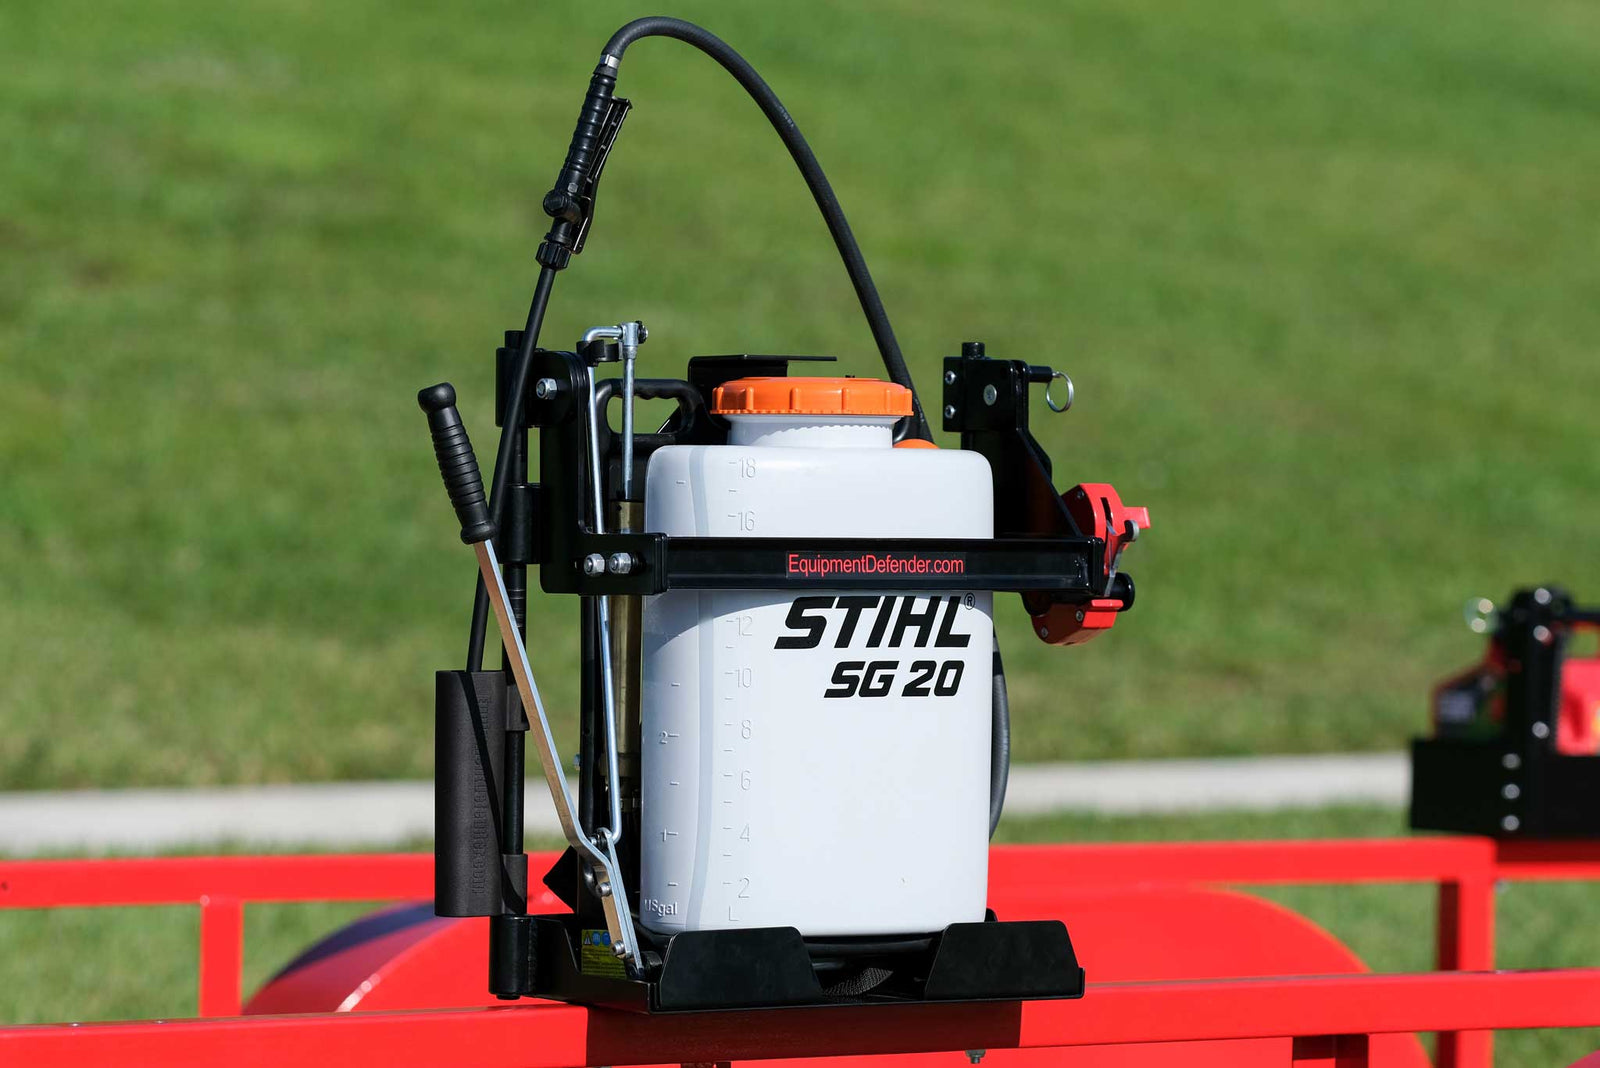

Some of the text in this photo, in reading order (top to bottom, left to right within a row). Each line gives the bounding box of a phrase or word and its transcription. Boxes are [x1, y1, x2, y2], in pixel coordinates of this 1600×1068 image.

[739, 457, 756, 478] 18
[738, 510, 755, 532] 16
[788, 554, 964, 578] EquipmentDefender.com
[735, 615, 753, 637] 12
[735, 667, 752, 689] 10
[823, 660, 965, 699] SG 20
[659, 730, 669, 745] 2
[740, 719, 751, 740] 8
[740, 769, 751, 791] 6
[739, 823, 750, 843] 4
[738, 876, 750, 899] 2
[728, 905, 739, 922] L
